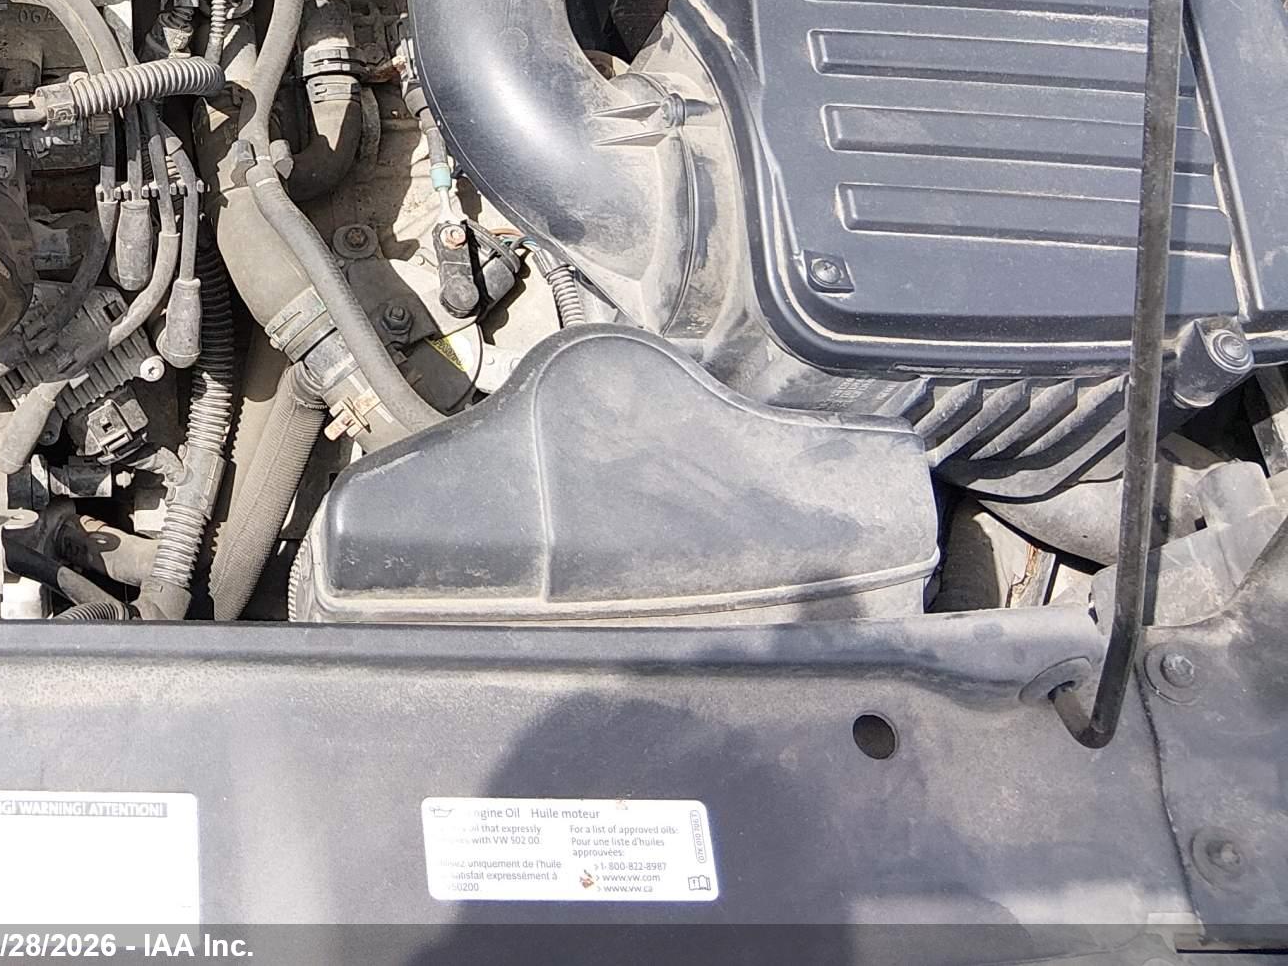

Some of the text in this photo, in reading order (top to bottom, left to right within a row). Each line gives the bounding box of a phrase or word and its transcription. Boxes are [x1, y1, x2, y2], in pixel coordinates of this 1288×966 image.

[19, 802, 86, 815] WARNING!
[89, 803, 163, 816] ATTENTION!
[505, 807, 520, 818] Oil
[531, 807, 600, 819] Huile moteur
[502, 825, 542, 835] expressly
[570, 826, 585, 834] For
[592, 825, 605, 833] list
[608, 825, 616, 833] of
[619, 825, 658, 836] approved
[472, 836, 491, 844] with
[493, 836, 508, 844] VW
[572, 837, 665, 846] Pour une liste d'huiles
[467, 860, 520, 871] uniquement
[522, 860, 533, 868] de
[486, 871, 549, 882] expressément
[602, 874, 660, 882] www.vw.com
